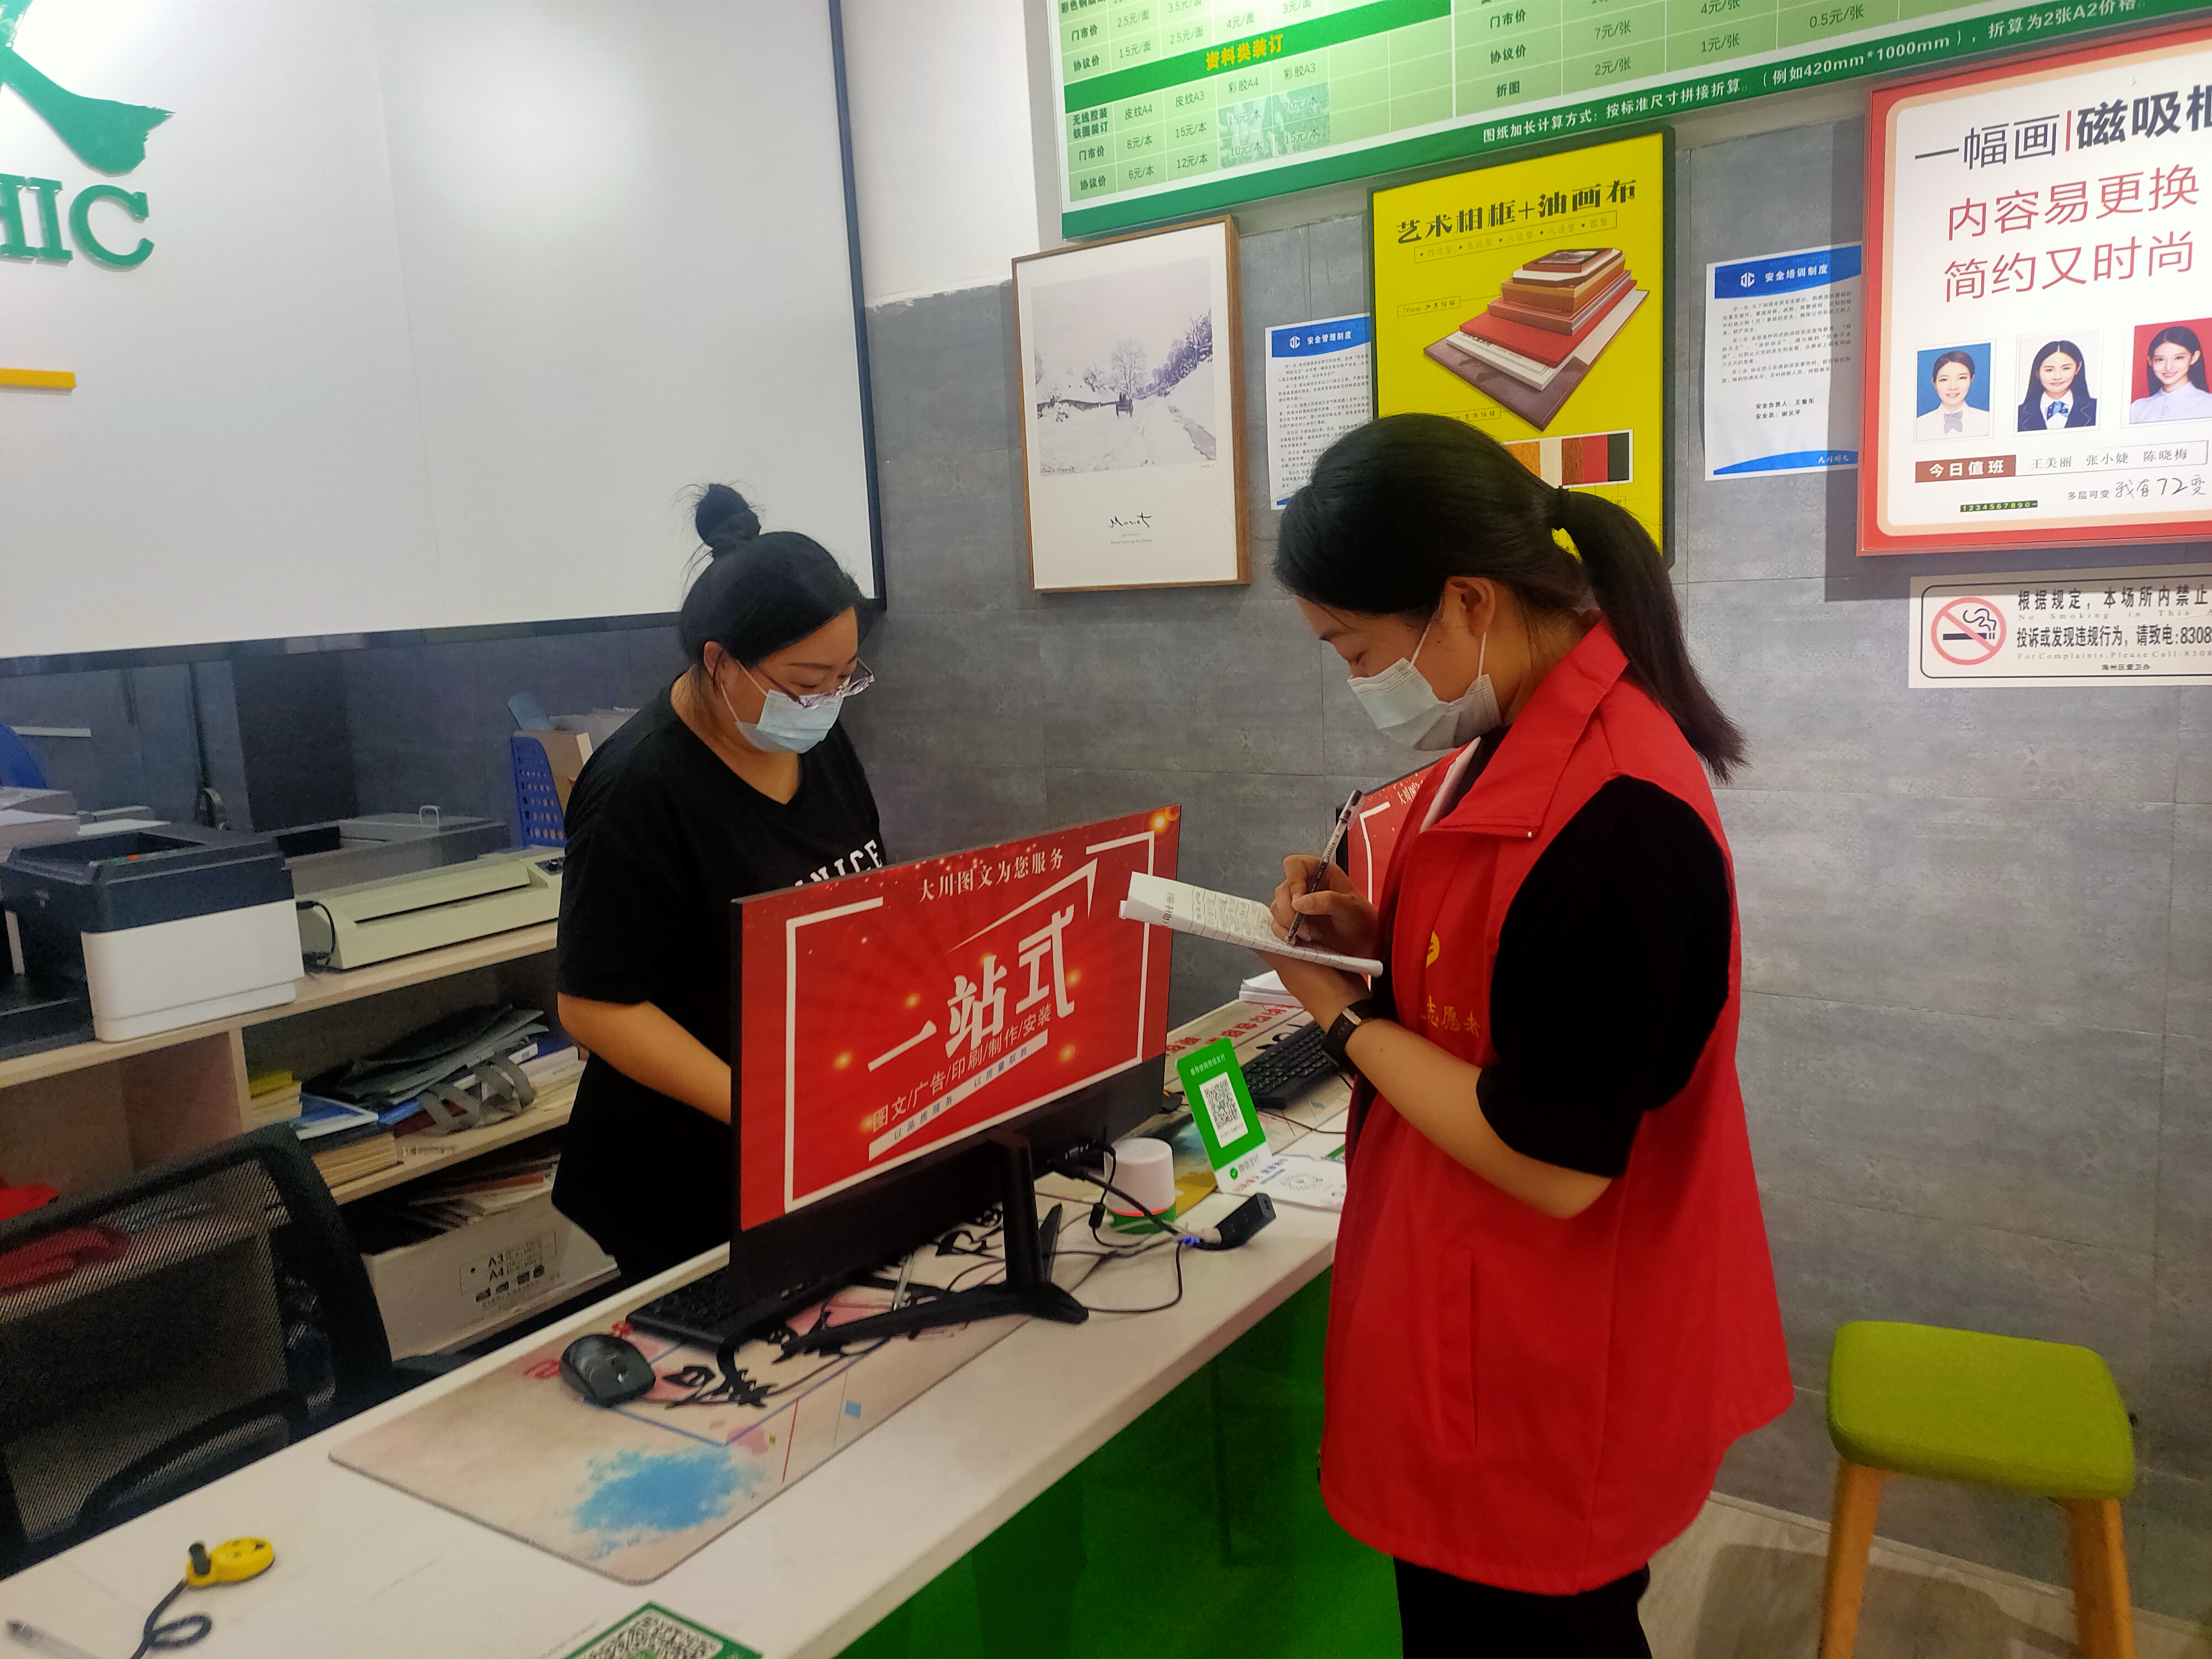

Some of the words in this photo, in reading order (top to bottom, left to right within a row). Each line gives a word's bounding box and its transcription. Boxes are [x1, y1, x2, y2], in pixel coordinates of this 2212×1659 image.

[1071, 24, 1098, 41] 门市价
[1117, 9, 1150, 27] 2.5元/面
[1227, 12, 1255, 28] 4元/面
[1490, 9, 1527, 29] 门市价
[1594, 19, 1631, 40] 7元/张
[1701, 0, 1740, 15] 4元/张
[1490, 44, 1527, 65] 协议价
[1594, 56, 1631, 76] 2元/张
[1701, 32, 1740, 54] 1元/张
[1809, 3, 1864, 29] 0.5元/张
[1073, 54, 1099, 72] 协议价
[1119, 40, 1151, 59] 1.5元/面
[1170, 25, 1204, 45] 2.5元/面
[1206, 34, 1284, 71] 资料类装订
[1124, 103, 1153, 121] 皮纹A4
[1175, 91, 1205, 107] 皮纹A3
[1228, 77, 1259, 94] 彩胶A4
[1284, 62, 1316, 81] 彩胶A3
[1496, 80, 1520, 98] 折图
[1079, 144, 1105, 162] 门市价
[1126, 133, 1153, 150] 8元/本
[1175, 121, 1207, 138] 15元/本
[1228, 108, 1261, 126] 15元/本
[1080, 174, 1106, 191] 协议价
[1128, 164, 1155, 180] 6元/本
[1176, 152, 1208, 169] 12元/本
[1229, 139, 1263, 156] 10元/本
[1285, 127, 1319, 144] 15元/本
[1914, 113, 2060, 170] 一幅画
[1396, 179, 1637, 244] 艺术相框+油画布
[1948, 164, 2198, 241] 内容易更换
[1765, 264, 1828, 283] 安全培训制度
[1944, 231, 2194, 303] 简约又时尚
[1307, 330, 1352, 345] 安全管理制度
[1929, 460, 2005, 479] 今日值班
[2031, 455, 2072, 470] 王美丽
[2142, 447, 2188, 463] 陈晓梅
[2067, 489, 2110, 500] 多层可变
[2115, 474, 2206, 499] 我有72变
[918, 847, 1064, 904] 大川图文为您服务
[868, 904, 1075, 1072] 一站式
[873, 1001, 1052, 1134] 图文/广告/印刷/制作/安装
